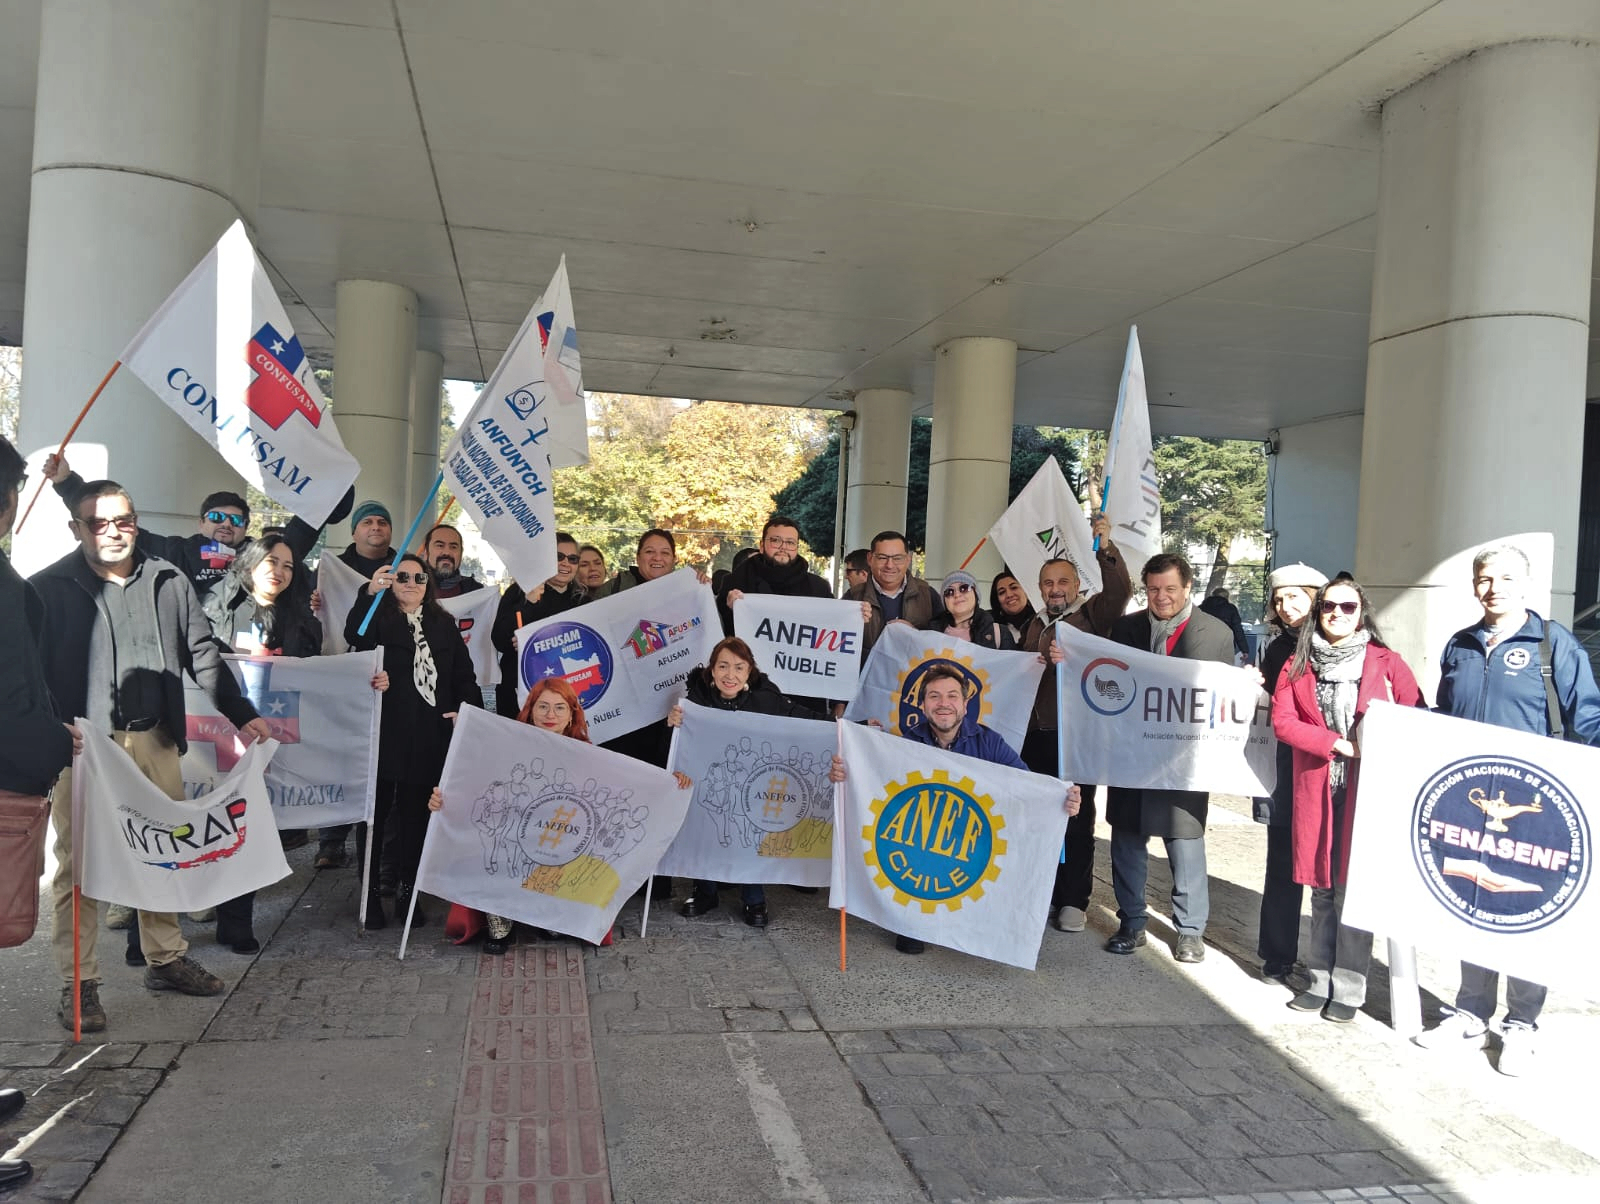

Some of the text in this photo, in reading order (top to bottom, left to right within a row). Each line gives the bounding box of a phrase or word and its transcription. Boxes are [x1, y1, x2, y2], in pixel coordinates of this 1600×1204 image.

[256, 353, 314, 411] CONFUSAM
[478, 418, 547, 496] ANFUNTCH
[467, 482, 487, 498] DE
[489, 473, 509, 490] DE
[496, 483, 544, 538] FUNCIONARIOS
[668, 616, 701, 638] AFUSAM
[534, 628, 582, 654] FEFUSAM
[658, 647, 690, 667] AFUSAM
[774, 651, 837, 677] ÑUBLE
[653, 673, 686, 692] CHILLÁN
[593, 707, 622, 725] ÑUBLE
[1143, 731, 1174, 741] Asociación
[880, 789, 983, 862] ANEF
[1422, 765, 1581, 862] FEDERACIÓN NACIONAL DE ASOCIACIONES
[1429, 819, 1571, 871] FENASENF
[889, 850, 969, 892] CHILE
[1469, 904, 1476, 914] Y
[1476, 908, 1544, 924] ENFERMEROS
[1541, 900, 1558, 914] DE
[1553, 876, 1577, 904] CHILE
